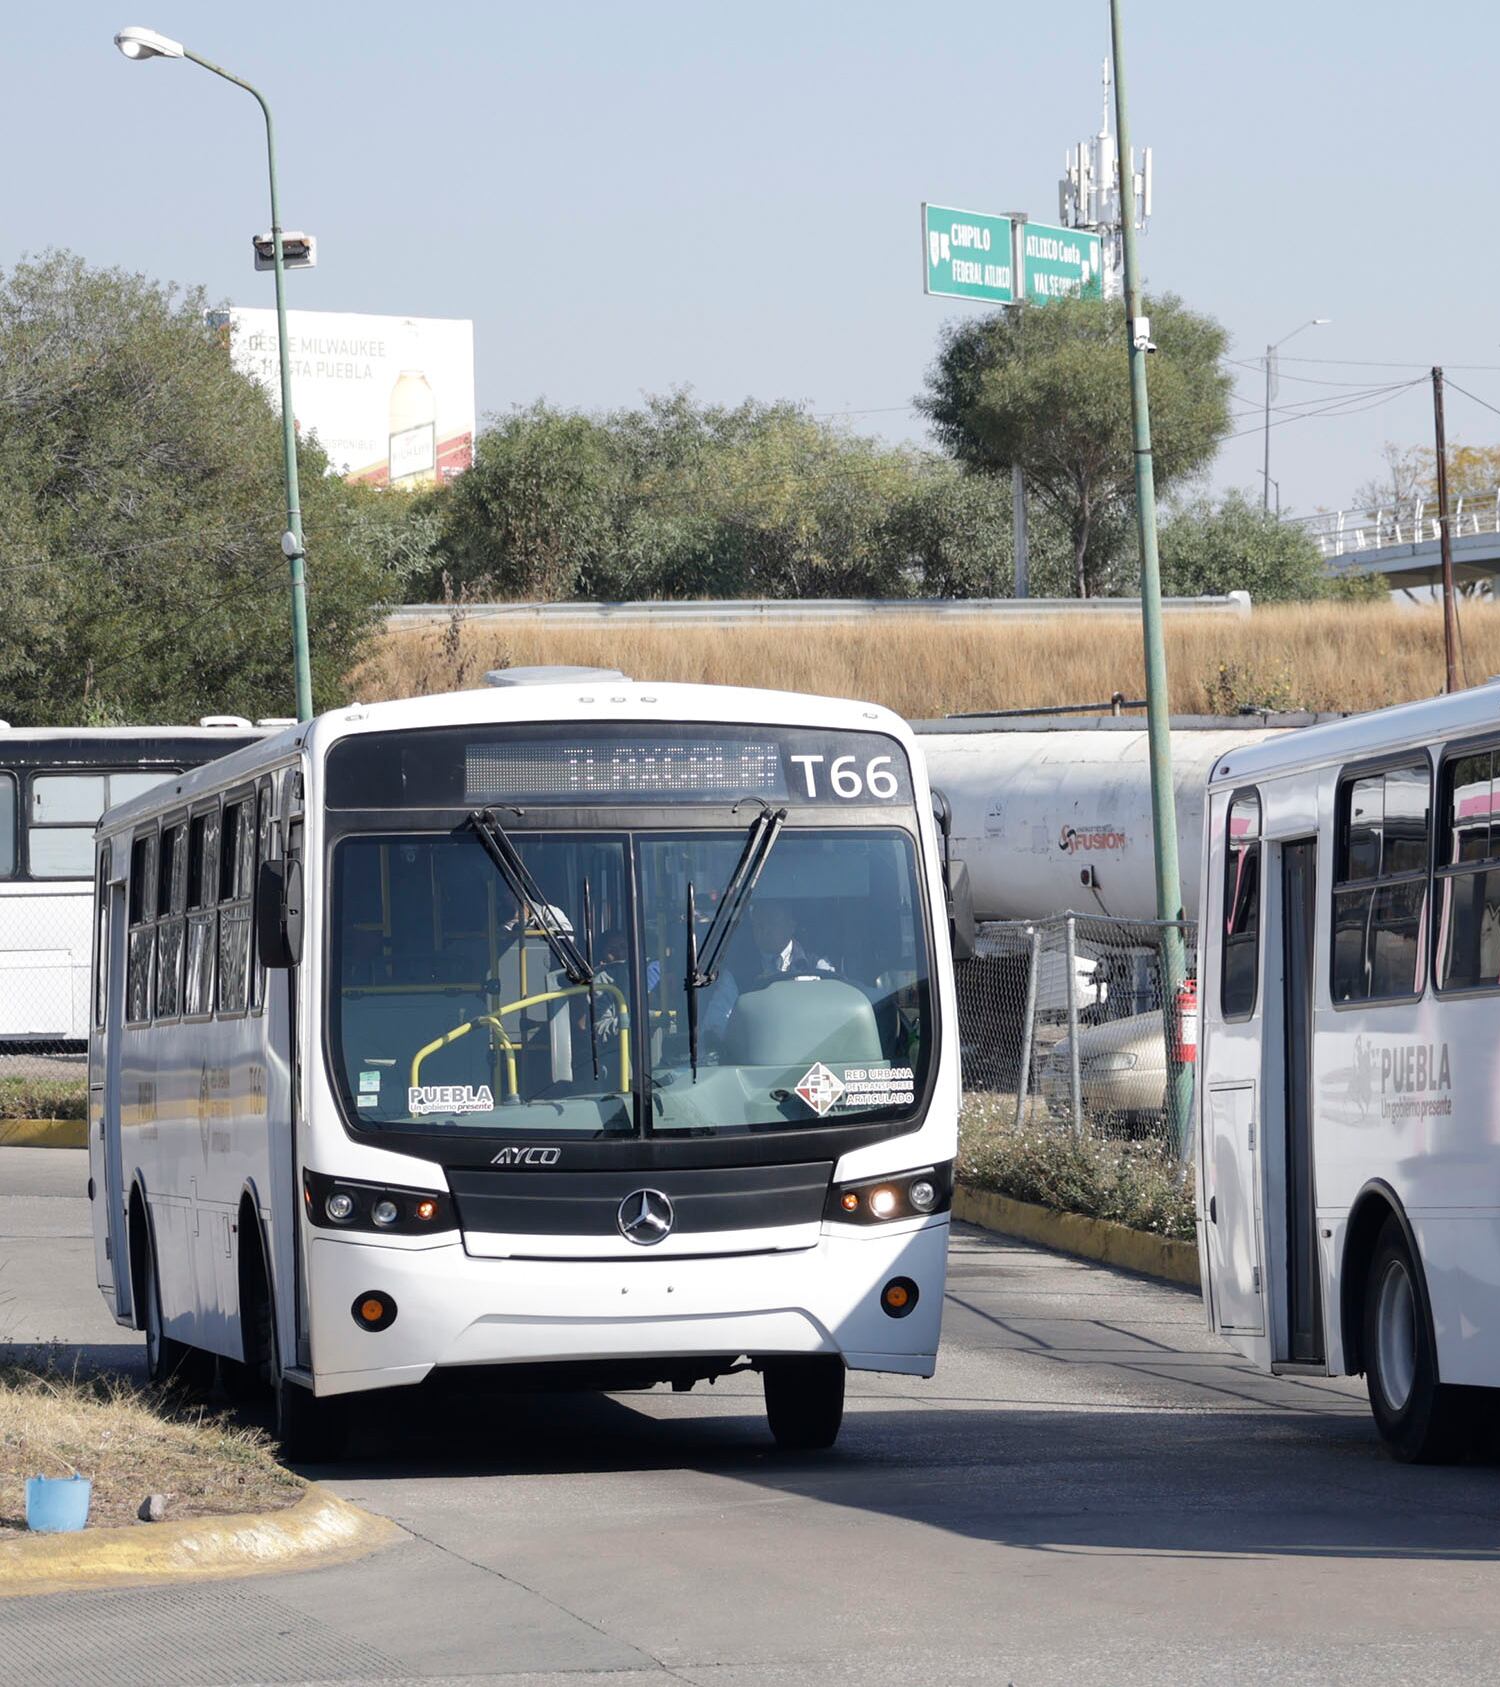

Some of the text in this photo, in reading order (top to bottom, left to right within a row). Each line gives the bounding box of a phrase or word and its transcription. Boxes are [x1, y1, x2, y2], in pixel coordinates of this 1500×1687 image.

[951, 223, 991, 252] CHIPILO
[1026, 235, 1057, 262] ATLIXCO
[952, 259, 983, 286] FEDERAL
[249, 335, 386, 358] DESE MILWAUKEE
[316, 361, 372, 379] PUEBLA
[790, 754, 899, 799] T66
[845, 1068, 913, 1080] RED URBANA
[1381, 1043, 1452, 1094] PUEBLA
[410, 1087, 492, 1103] PUEBLA
[859, 1081, 914, 1091] TRANSPORTE
[422, 1103, 457, 1112] gobierno
[457, 1103, 492, 1112] presente
[846, 1093, 914, 1105] ARTICULADO
[1381, 1095, 1452, 1125] Un gobierno presente
[490, 1147, 562, 1165] AYCO
